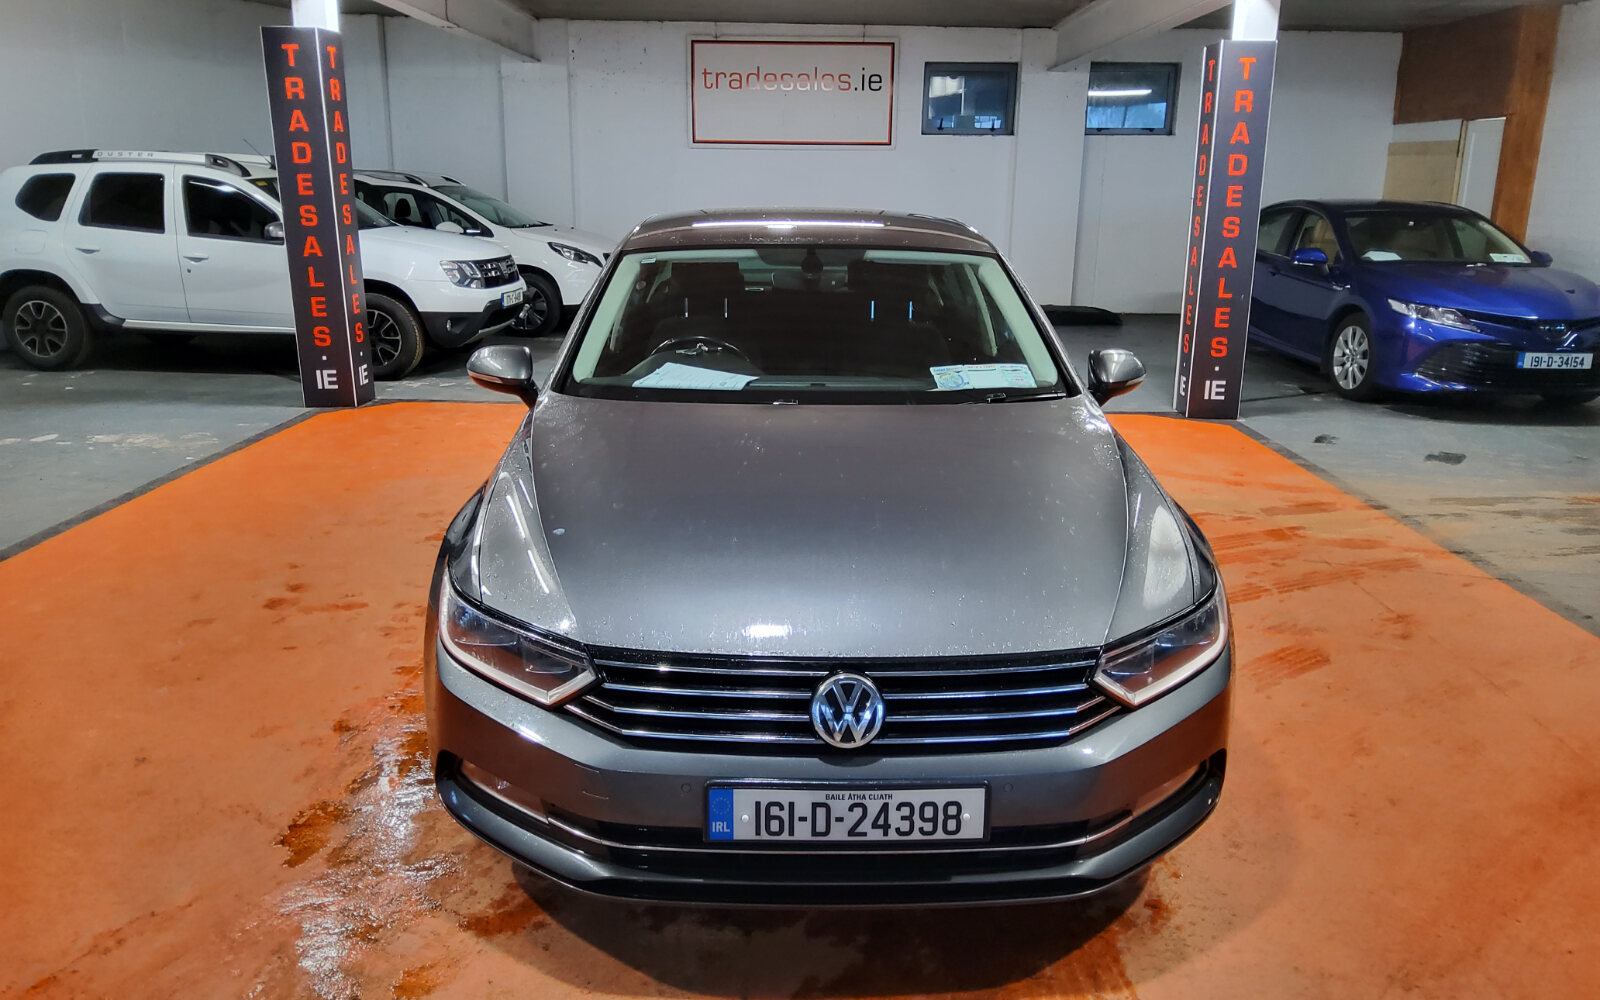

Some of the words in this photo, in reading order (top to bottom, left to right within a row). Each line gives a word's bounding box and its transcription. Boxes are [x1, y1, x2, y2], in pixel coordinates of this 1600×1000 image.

[701, 66, 883, 92] tradesales.ie
[825, 793, 846, 801] BAILE
[868, 793, 893, 801] CLIATH
[711, 821, 731, 833] IRL
[754, 800, 963, 837] 161-D-24398
